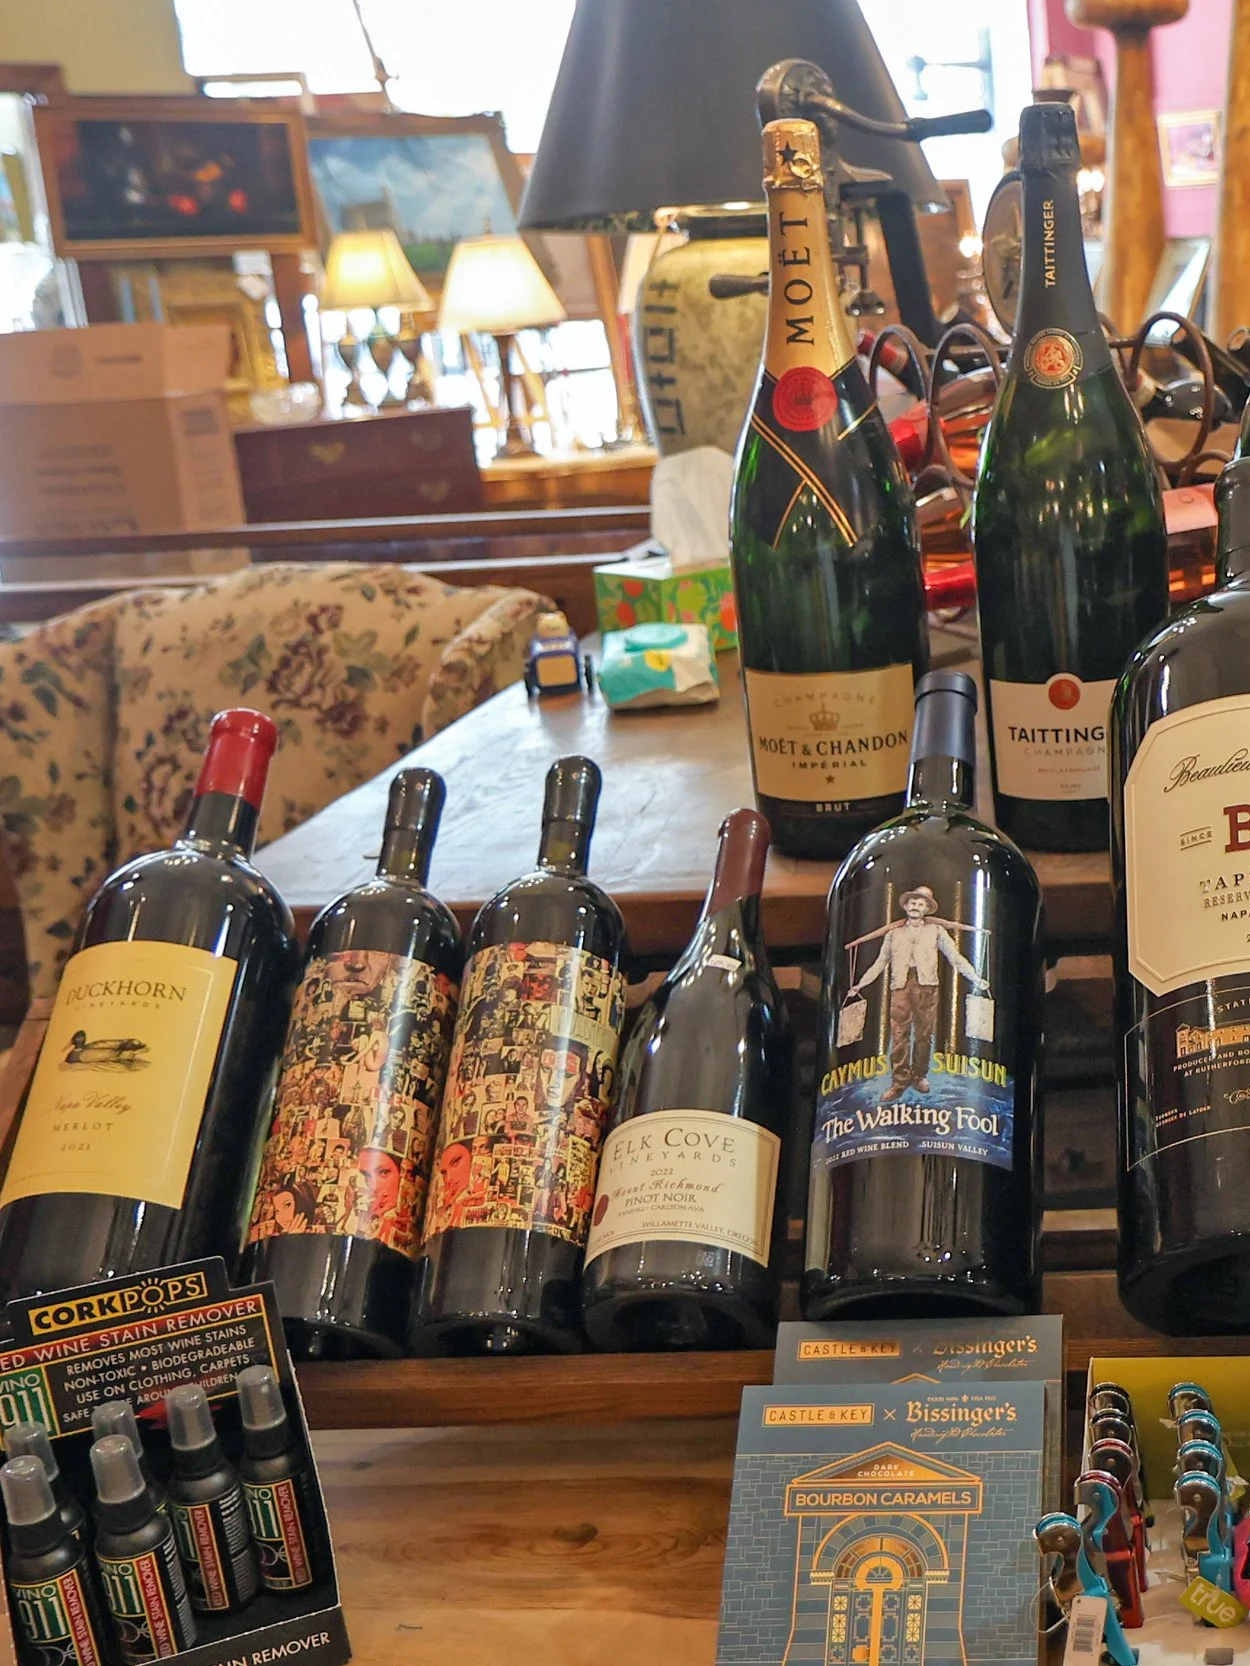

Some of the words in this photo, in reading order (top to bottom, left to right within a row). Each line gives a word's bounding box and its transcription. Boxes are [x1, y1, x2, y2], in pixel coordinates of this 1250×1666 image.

[1043, 199, 1056, 289] TAITTINGER
[779, 212, 815, 345] MOËT
[802, 744, 812, 756] &
[816, 730, 908, 756] CHANDON
[1008, 726, 1105, 743] TAITTING
[1024, 746, 1106, 755] CHAMPAGN
[816, 803, 850, 812] BRUT
[1180, 831, 1213, 846] SINCE
[66, 981, 187, 1005] DUCKHORN
[74, 1001, 161, 1010] VINEYARDS
[1174, 1055, 1214, 1072] PRODUCED
[1218, 1051, 1234, 1060] AND
[821, 1055, 888, 1096] CAYMUS
[931, 1051, 1007, 1087] SUISUN
[1184, 1069, 1194, 1077] AT
[53, 1123, 113, 1132] MERLOT
[821, 1117, 854, 1144] The
[856, 1104, 951, 1135] Walking
[955, 1106, 999, 1136] Fool
[613, 1135, 653, 1161] ELK
[664, 1128, 735, 1153] COVE
[841, 1148, 856, 1158] RED
[857, 1143, 878, 1154] WINE
[880, 1141, 909, 1150] BLEND
[920, 1140, 955, 1150] SUISUN
[957, 1144, 988, 1156] VALLEY
[609, 1151, 737, 1174] VINEYARDS
[650, 1168, 674, 1176] 2022
[649, 1178, 724, 1193] Richmond
[625, 1194, 660, 1207] PINOT
[663, 1193, 697, 1203] NOIR
[642, 1221, 694, 1229] WILLAMETTE
[34, 1278, 201, 1329] CORKPOPS
[34, 1339, 90, 1362] WINE
[101, 1323, 157, 1348] STAIN
[167, 1299, 257, 1331] REMOVER
[67, 1353, 125, 1375] REMOVES
[129, 1345, 165, 1361] MOST
[168, 1335, 201, 1353] WINE
[205, 1324, 247, 1343] STAINS
[804, 1344, 856, 1355] CASTLE
[871, 1343, 895, 1353] KEY
[64, 1366, 136, 1392] NON-TOXIC
[151, 1337, 255, 1371] BIODEGRADEABLE
[76, 1391, 100, 1404] USE
[106, 1385, 125, 1397] ON
[200, 1354, 250, 1375] CARPETS
[63, 1408, 91, 1422] SAFE
[769, 1410, 824, 1423] CASTLE
[841, 1409, 868, 1420] KEY
[905, 1401, 1017, 1426] Bissinger's
[857, 1470, 915, 1478] CHOCOLATE
[874, 1463, 900, 1471] DARK
[796, 1493, 878, 1507] BOURBON
[880, 1491, 972, 1505] CARAMELS
[15, 1585, 56, 1599] VINO
[1191, 1580, 1236, 1622] true
[19, 1597, 66, 1639] 911
[252, 1632, 330, 1665] REMOVER
